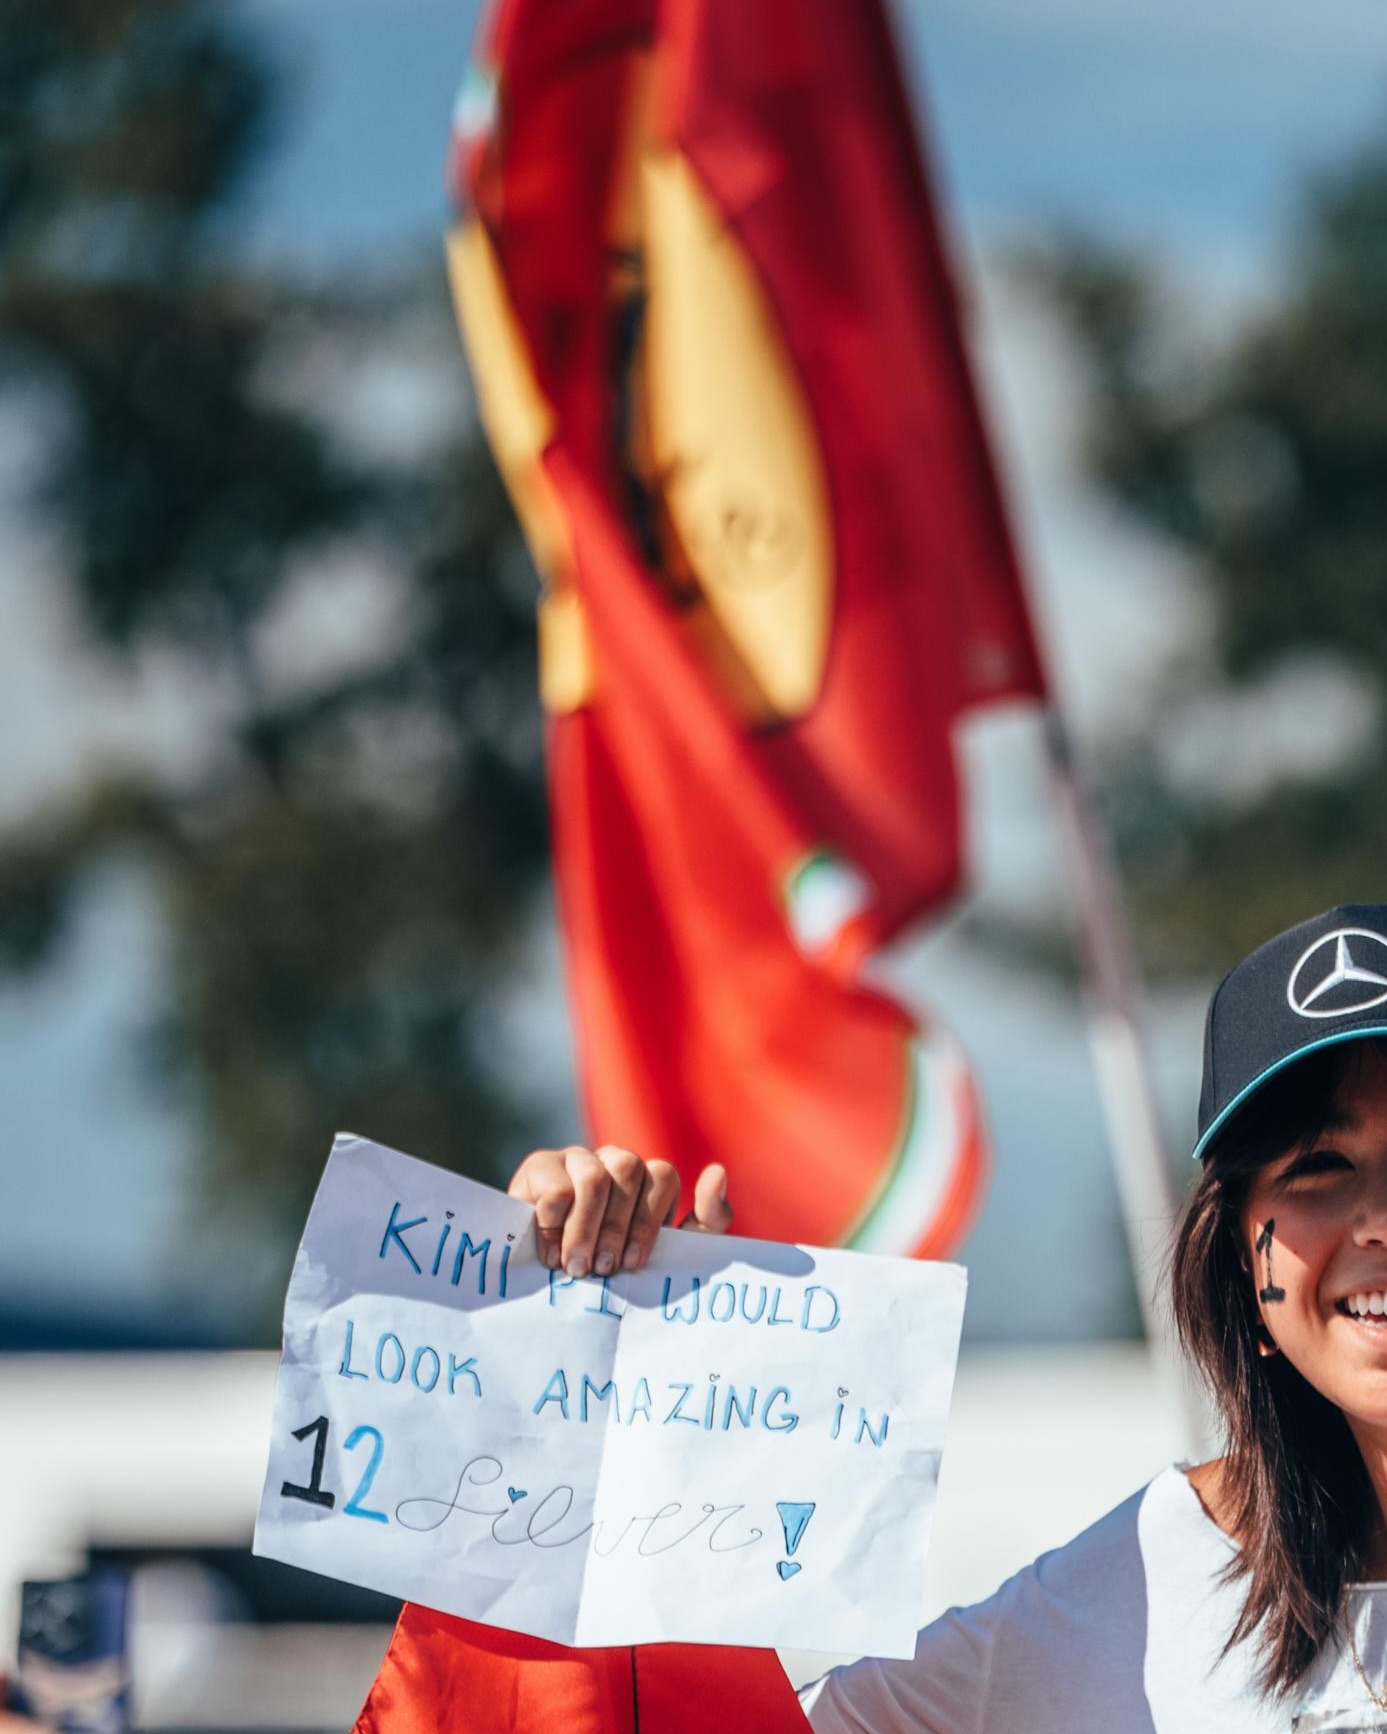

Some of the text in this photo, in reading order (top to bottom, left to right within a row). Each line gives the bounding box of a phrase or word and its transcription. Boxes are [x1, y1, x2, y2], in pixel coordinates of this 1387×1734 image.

[662, 1276, 842, 1333] WOULD
[339, 1320, 483, 1398] LOOK
[280, 1415, 390, 1525] 12
